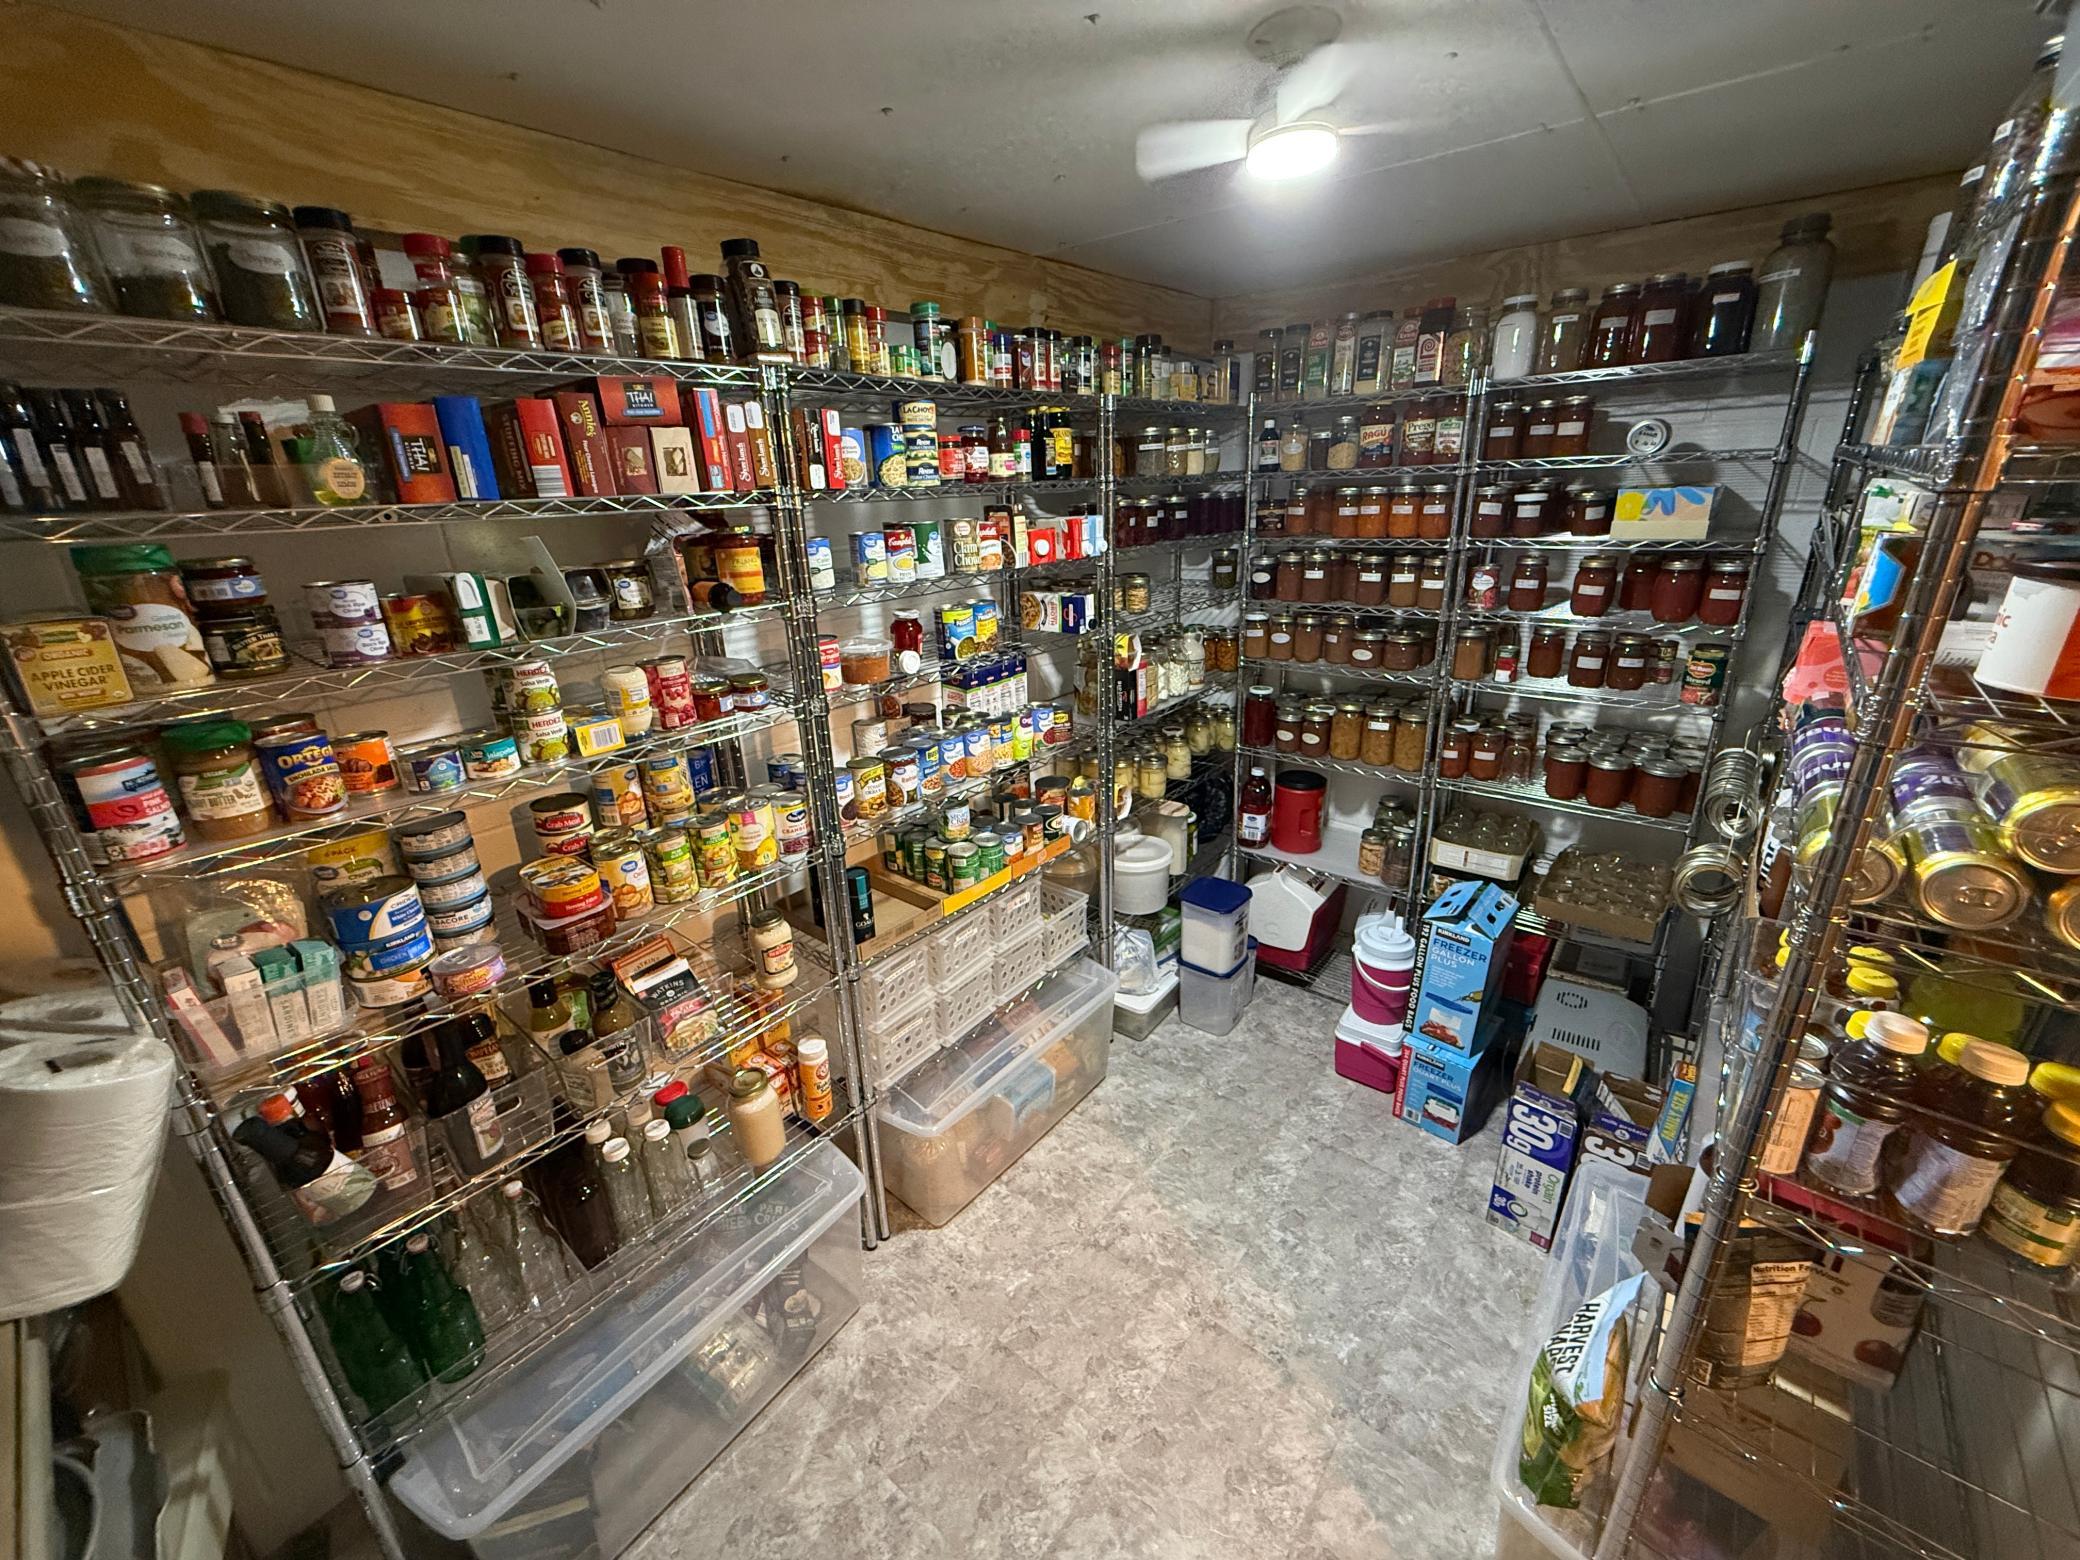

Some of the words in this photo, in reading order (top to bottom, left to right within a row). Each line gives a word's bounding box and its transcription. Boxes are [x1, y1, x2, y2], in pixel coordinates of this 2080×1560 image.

[626, 391, 653, 404] THAI
[578, 399, 597, 437] Annie's
[1408, 421, 1434, 433] Prego
[411, 437, 431, 472] THAI
[954, 541, 977, 555] Clam
[31, 666, 75, 682] APPLE
[77, 663, 116, 677] CIDER
[516, 665, 550, 677] HERDEZ
[43, 675, 108, 692] VINEGAR
[531, 716, 562, 729] HERDEZ
[386, 933, 416, 948] KIRKLAND
[1438, 928, 1470, 943] KIRKLAND
[1416, 939, 1428, 968] GALLON
[1432, 947, 1475, 966] GALLON
[1433, 938, 1488, 963] FREEZER
[1430, 955, 1457, 968] PLUS
[1412, 968, 1422, 987] PLUS
[651, 980, 685, 998] WATKINS
[1409, 988, 1419, 1009] FOOD
[1405, 1009, 1416, 1029] BAGS
[1413, 1061, 1454, 1082] FREEZER
[1670, 1090, 1689, 1112] SIZE
[1506, 1104, 1557, 1155] 30g
[1660, 1111, 1682, 1142] FAMILY
[1532, 1171, 1543, 1196] protein
[1543, 1173, 1560, 1204] Orgain
[1753, 1264, 1796, 1274] Nutrition
[1555, 1303, 1602, 1374] HARVEST
[1542, 1404, 1551, 1428] SIZE
